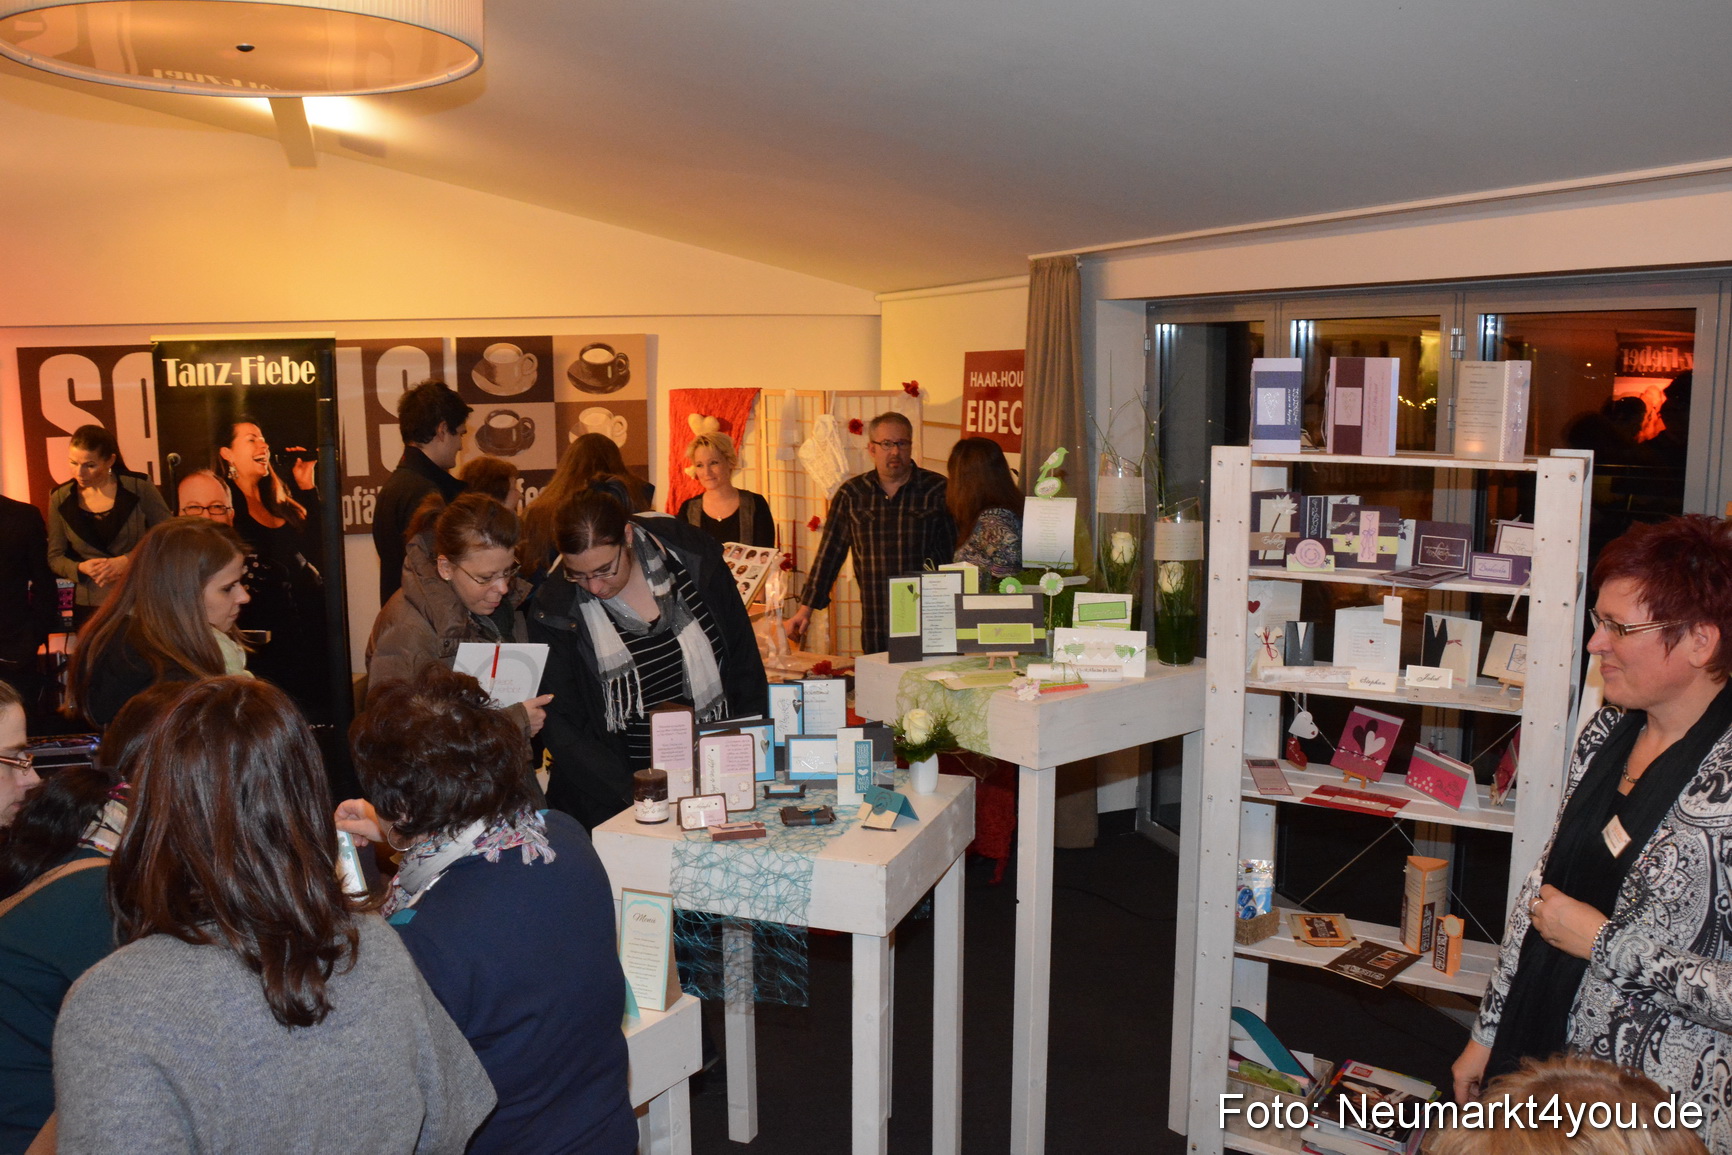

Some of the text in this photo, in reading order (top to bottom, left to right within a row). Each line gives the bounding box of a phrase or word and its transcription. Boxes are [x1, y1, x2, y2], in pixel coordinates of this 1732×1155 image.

[161, 355, 316, 387] Tanz-Fiebe
[970, 370, 1024, 387] HAAR-HOU
[966, 400, 1022, 435] EIBEC
